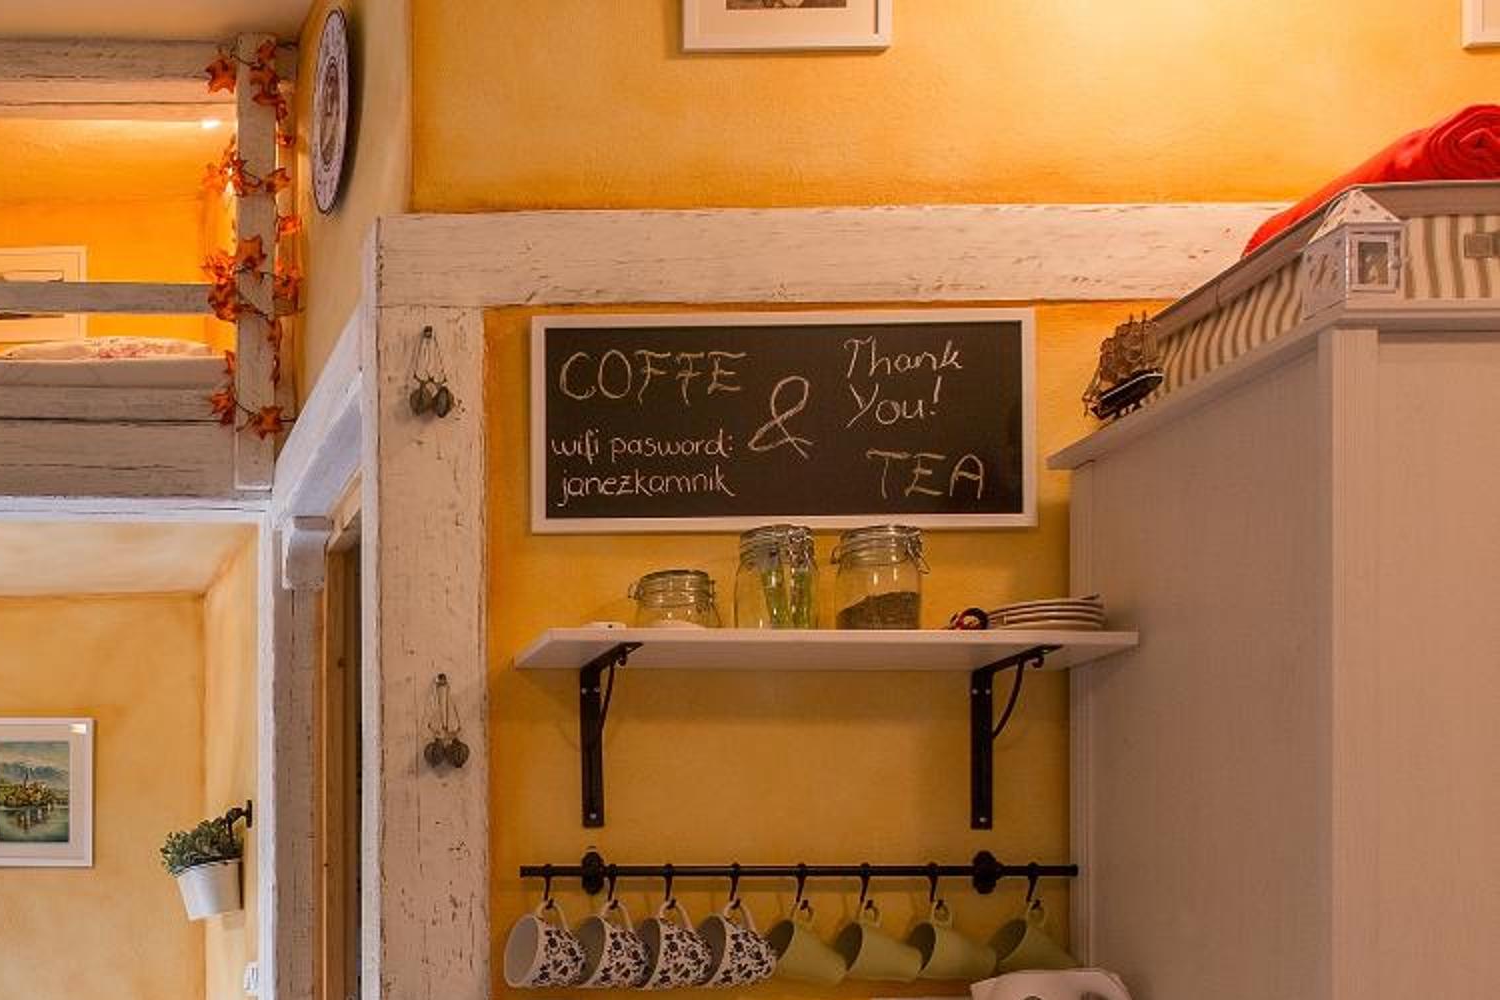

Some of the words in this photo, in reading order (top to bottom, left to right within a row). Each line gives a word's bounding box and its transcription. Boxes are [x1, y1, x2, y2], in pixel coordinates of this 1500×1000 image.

[559, 349, 746, 404] COFFE
[844, 336, 962, 379] Thank
[748, 376, 813, 458] &
[845, 375, 942, 428] You!
[551, 429, 600, 465] wifi
[611, 428, 733, 463] pasword:
[557, 464, 736, 507] janezkamnik
[866, 449, 986, 500] TEA
